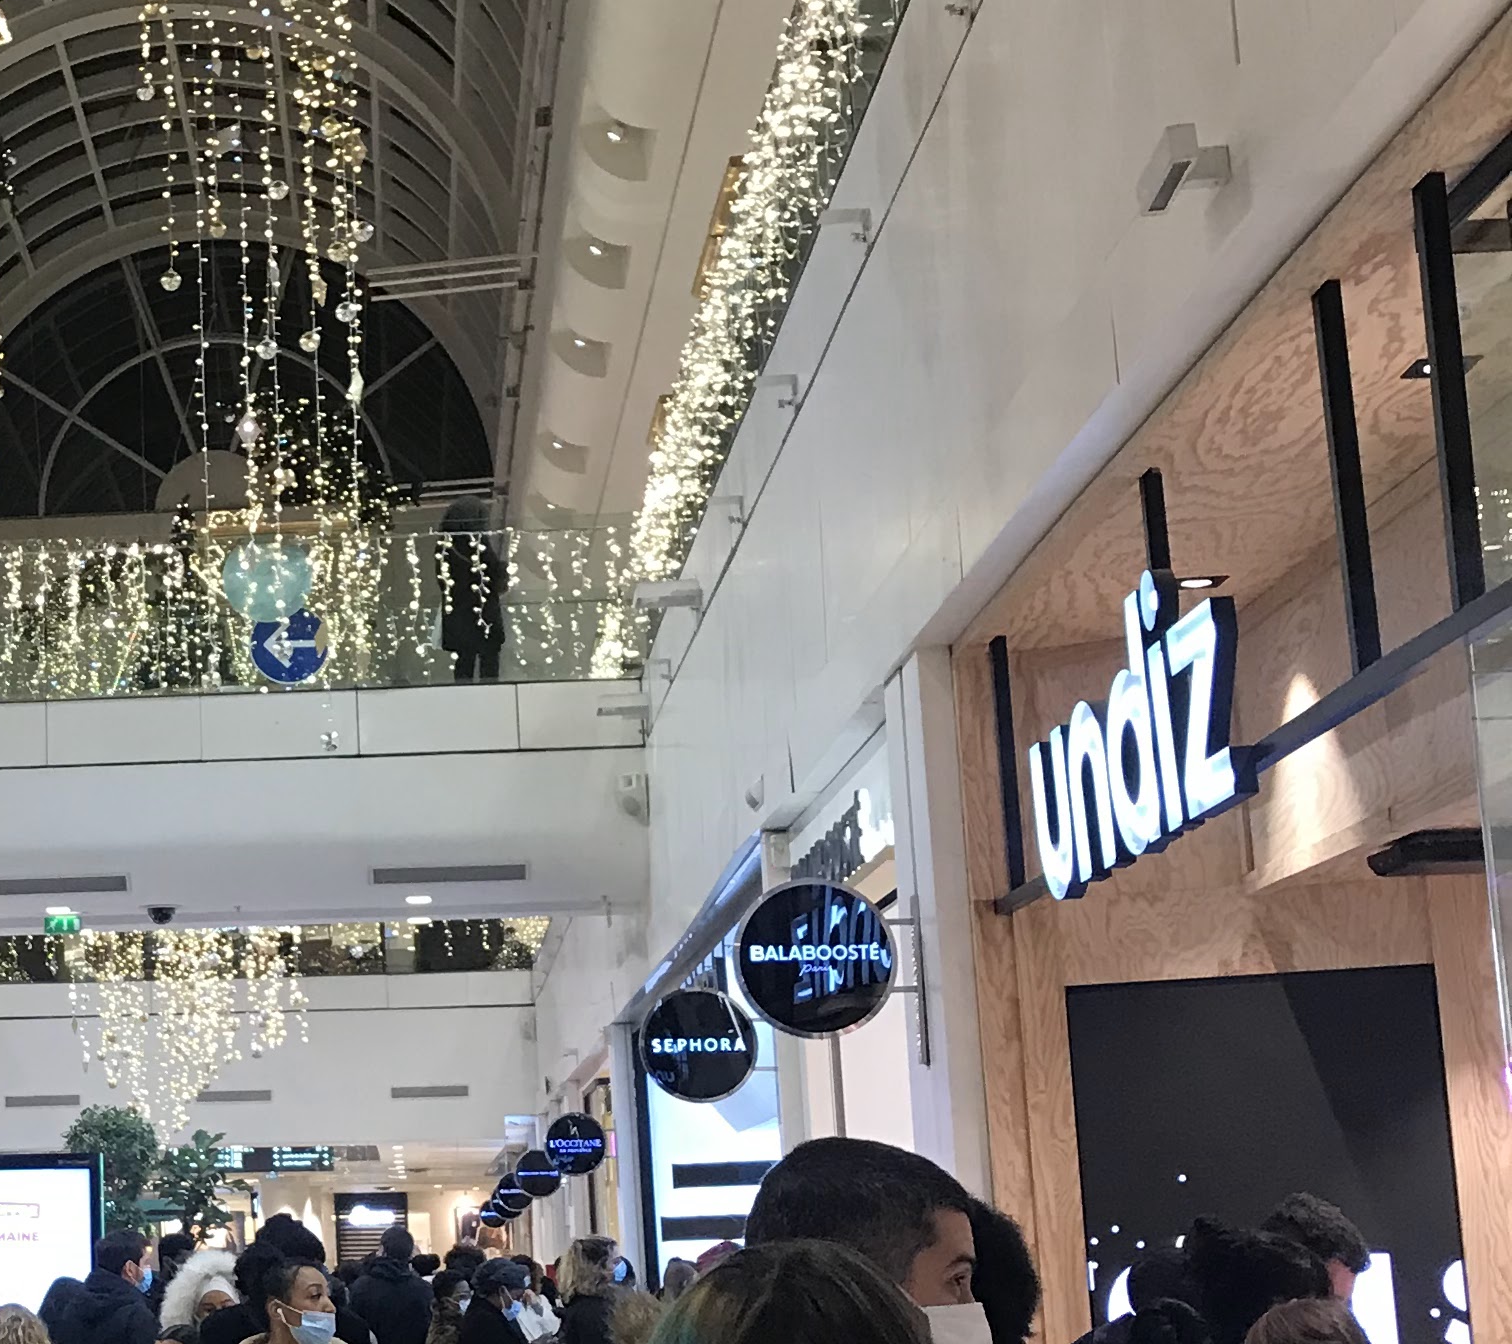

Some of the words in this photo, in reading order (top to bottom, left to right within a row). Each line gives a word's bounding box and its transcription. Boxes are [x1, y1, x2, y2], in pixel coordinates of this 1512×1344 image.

[1029, 569, 1237, 901] undiz
[749, 942, 880, 962] BALABOOSTÉ
[650, 1037, 748, 1054] SEPHORA
